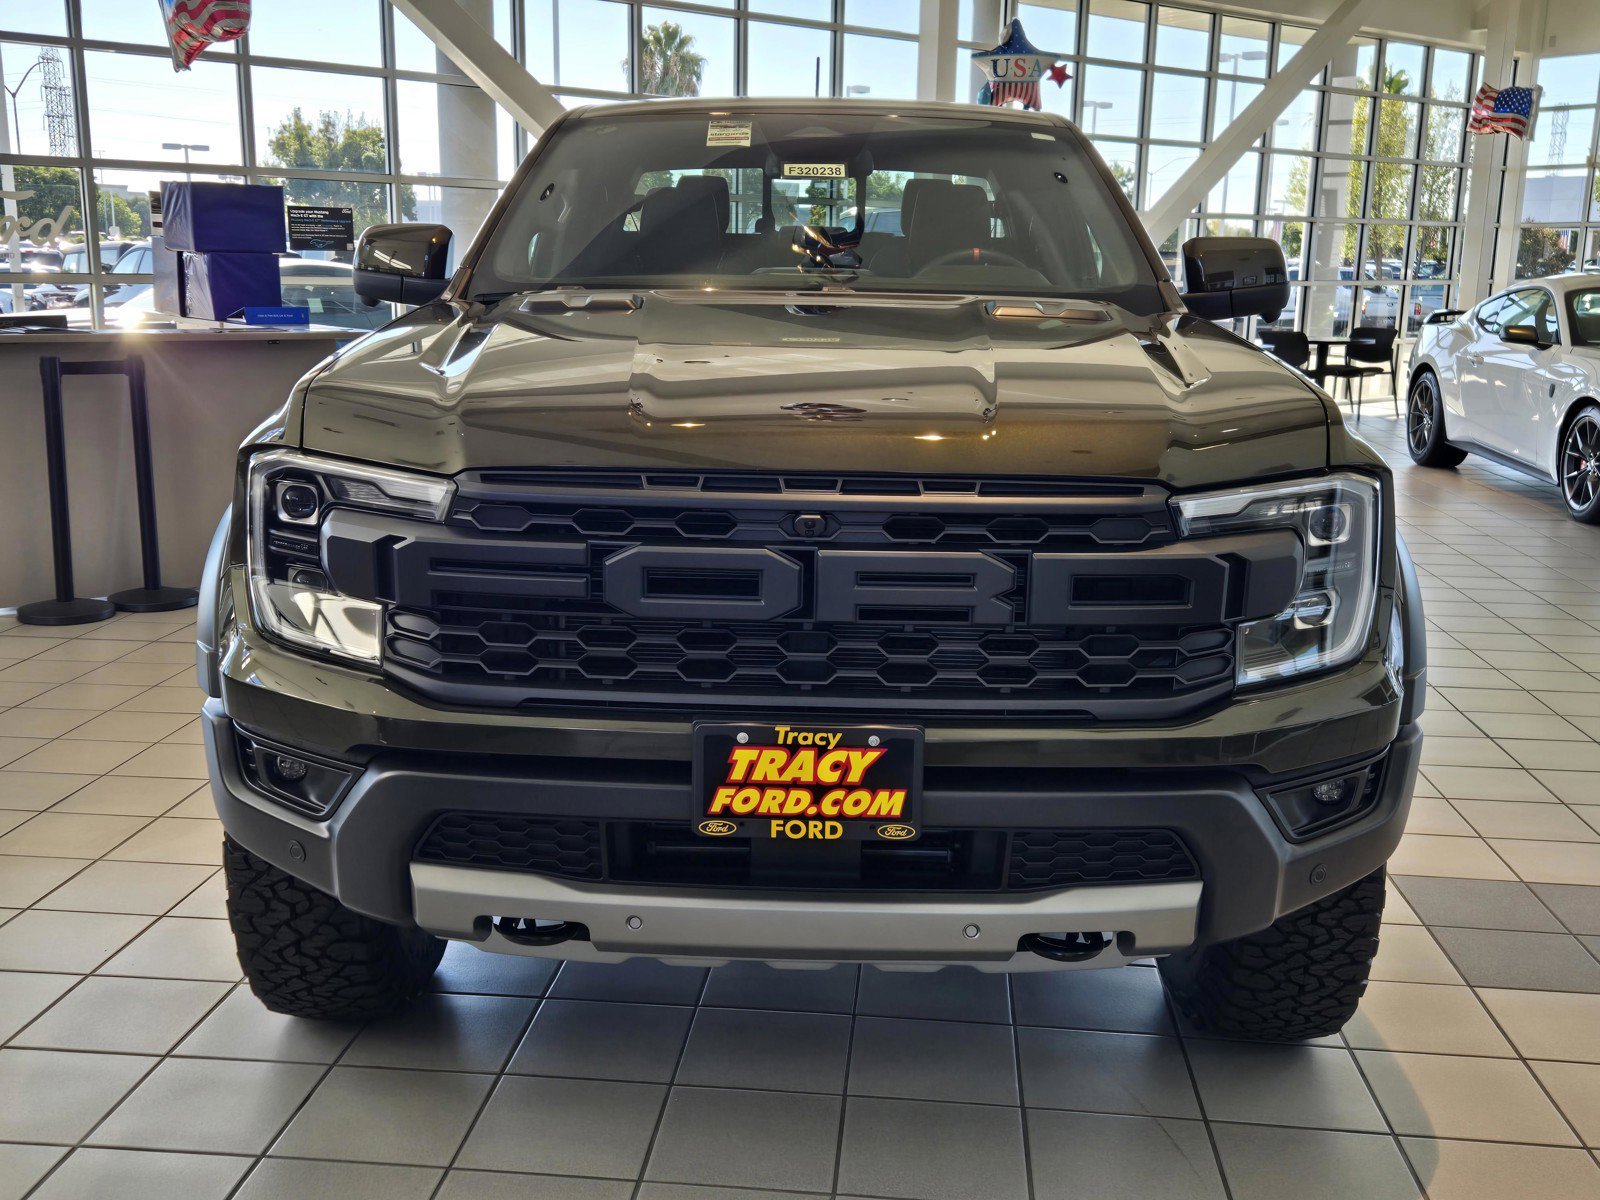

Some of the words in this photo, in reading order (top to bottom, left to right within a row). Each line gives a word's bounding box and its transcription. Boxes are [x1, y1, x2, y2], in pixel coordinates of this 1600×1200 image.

[788, 166, 842, 176] F320238
[393, 536, 1229, 626] FORD
[775, 725, 842, 749] Tracy
[726, 746, 888, 785] TRACY
[707, 786, 907, 818] FORD.COM
[770, 819, 844, 840] FORD
